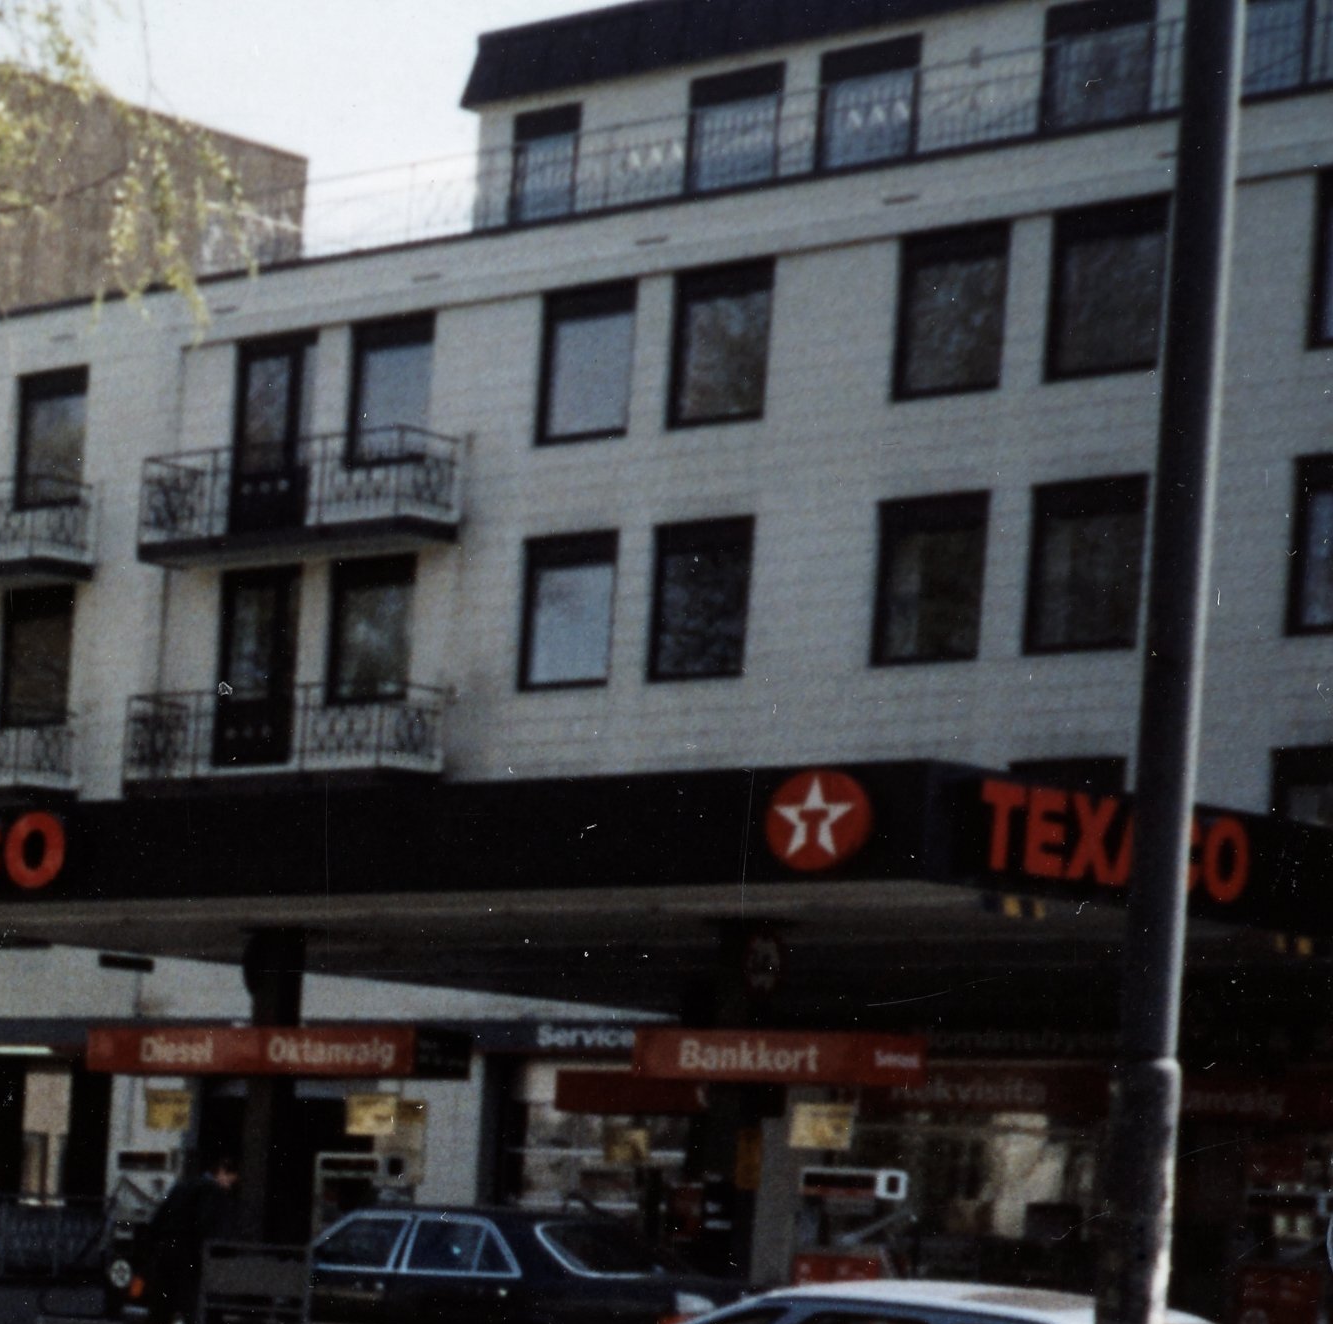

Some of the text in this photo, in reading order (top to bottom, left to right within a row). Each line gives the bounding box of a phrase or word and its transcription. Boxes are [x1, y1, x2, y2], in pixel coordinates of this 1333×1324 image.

[980, 776, 1252, 905] TEXO
[139, 1035, 215, 1064] Diesel
[266, 1035, 397, 1069] Oktanvalg
[677, 1037, 820, 1073] Bankkort
